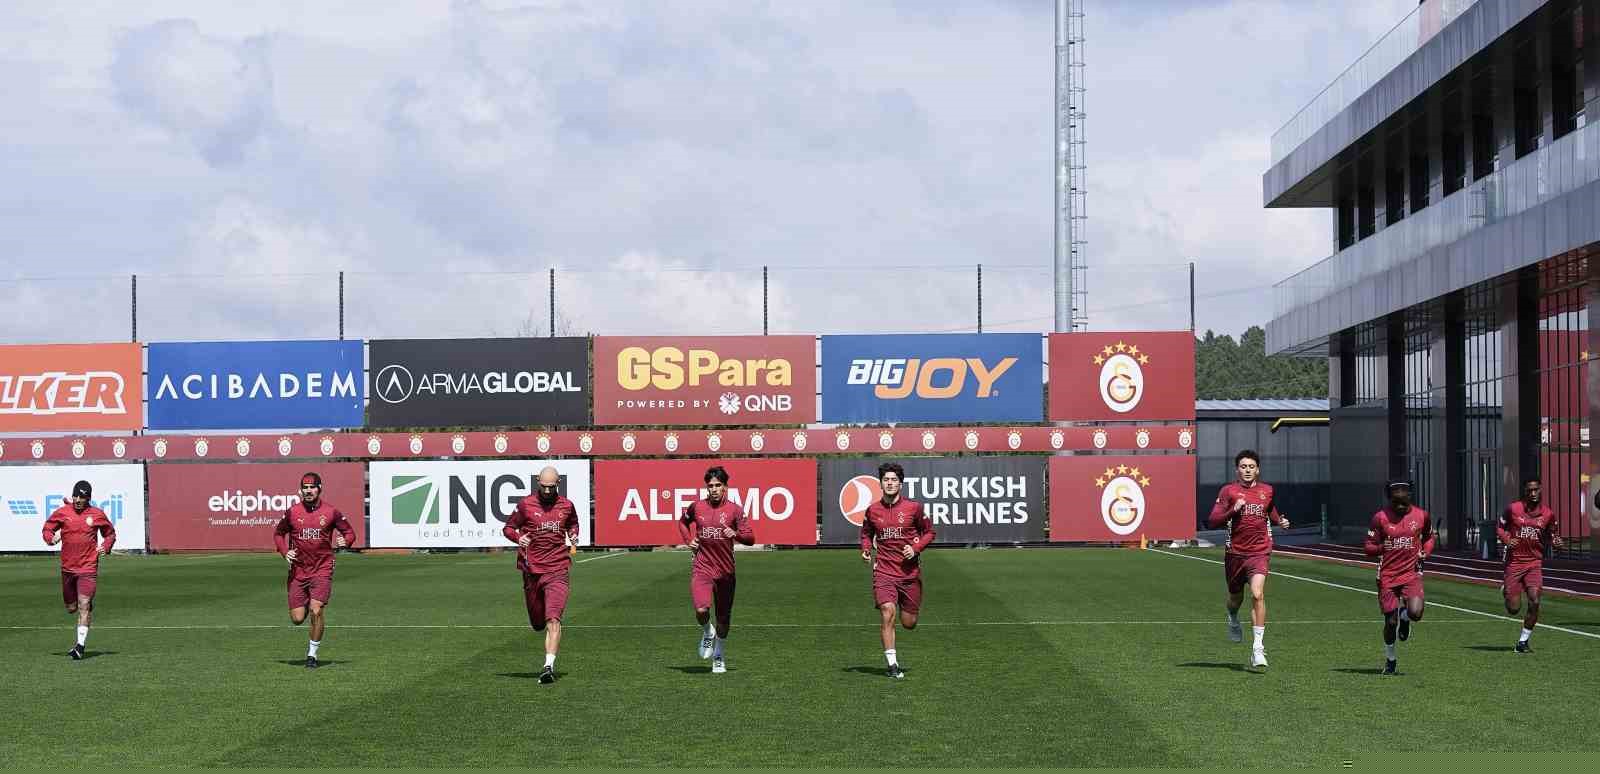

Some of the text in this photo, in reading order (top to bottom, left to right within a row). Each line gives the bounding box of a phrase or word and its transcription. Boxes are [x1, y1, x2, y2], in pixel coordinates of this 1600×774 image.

[155, 370, 357, 400] ACIBADEM
[617, 400, 710, 408] POWERED BY
[744, 394, 792, 412] QNB
[903, 475, 1026, 499] TURKISH
